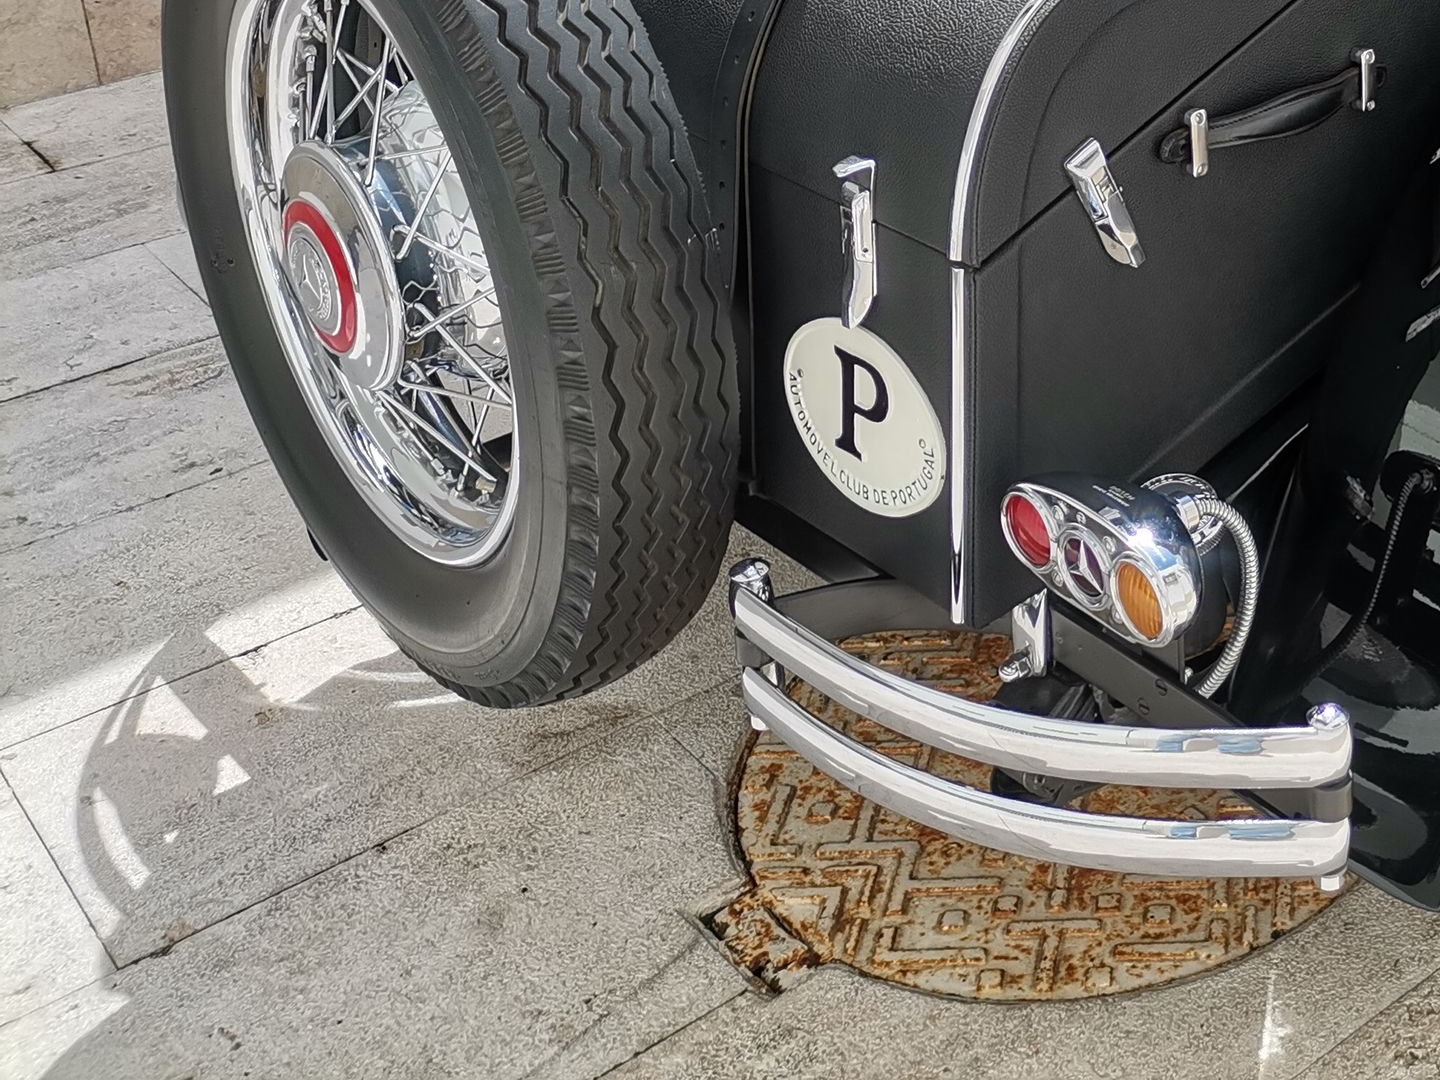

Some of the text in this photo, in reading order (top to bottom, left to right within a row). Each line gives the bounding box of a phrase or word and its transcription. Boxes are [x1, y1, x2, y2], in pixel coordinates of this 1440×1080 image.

[788, 372, 935, 506] AUTOMOVEL CLUB DE PORTUGAL
[833, 344, 889, 462] P
